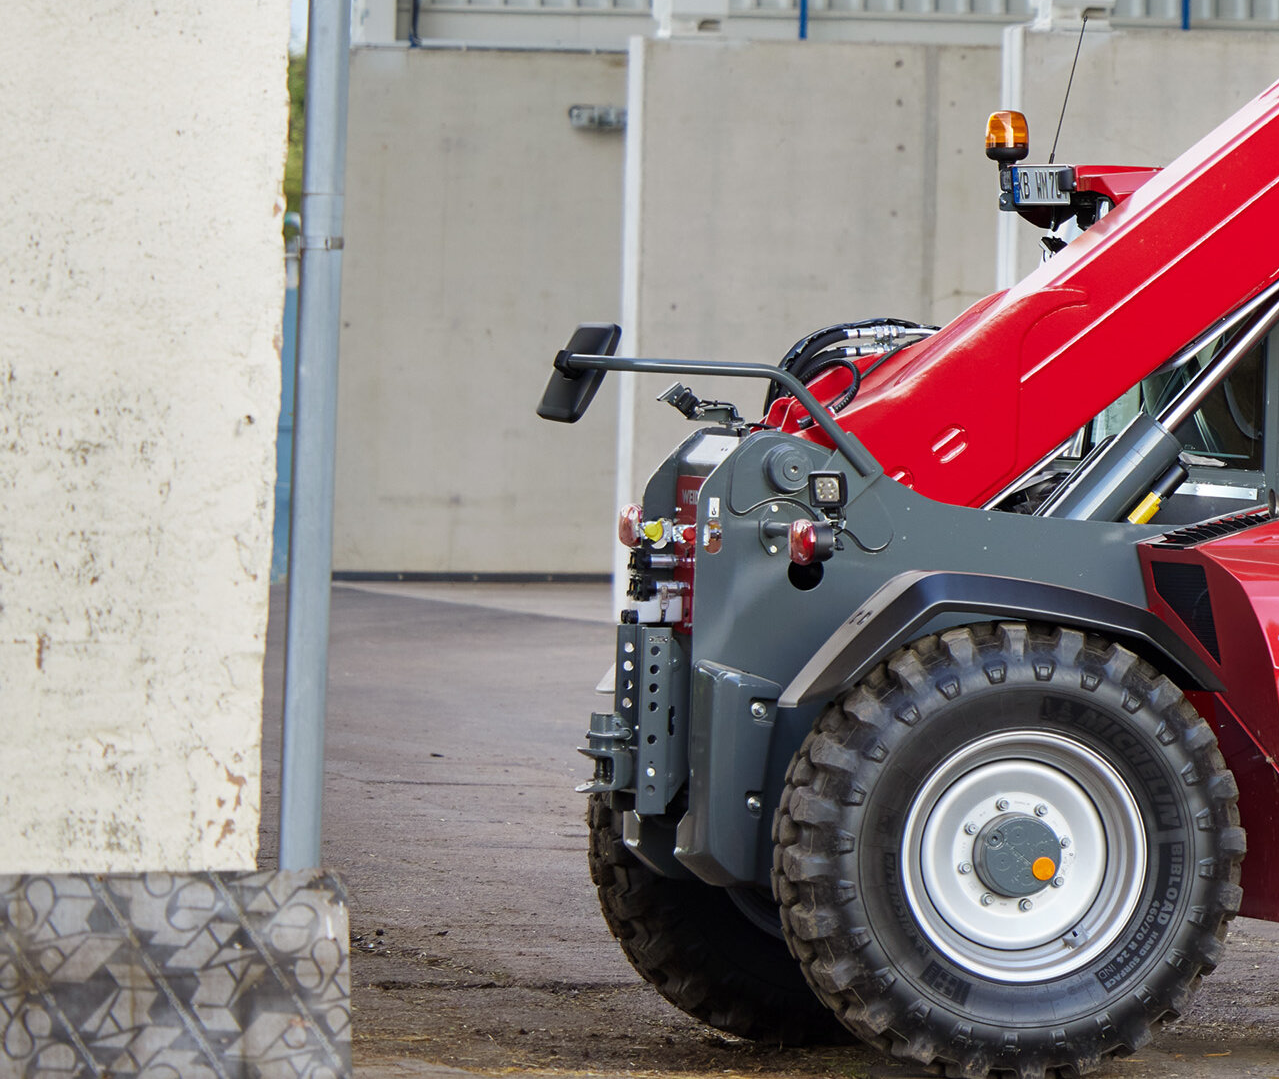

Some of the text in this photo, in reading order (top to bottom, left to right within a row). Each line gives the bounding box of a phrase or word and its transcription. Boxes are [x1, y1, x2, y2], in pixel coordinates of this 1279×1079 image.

[1076, 705, 1181, 830] MICHELIN
[1155, 842, 1182, 927] BIBLOAD
[1134, 898, 1161, 941] 460/70
[1096, 962, 1117, 980] IND
[1103, 955, 1141, 989] SURFACE
[1115, 948, 1130, 964] 24
